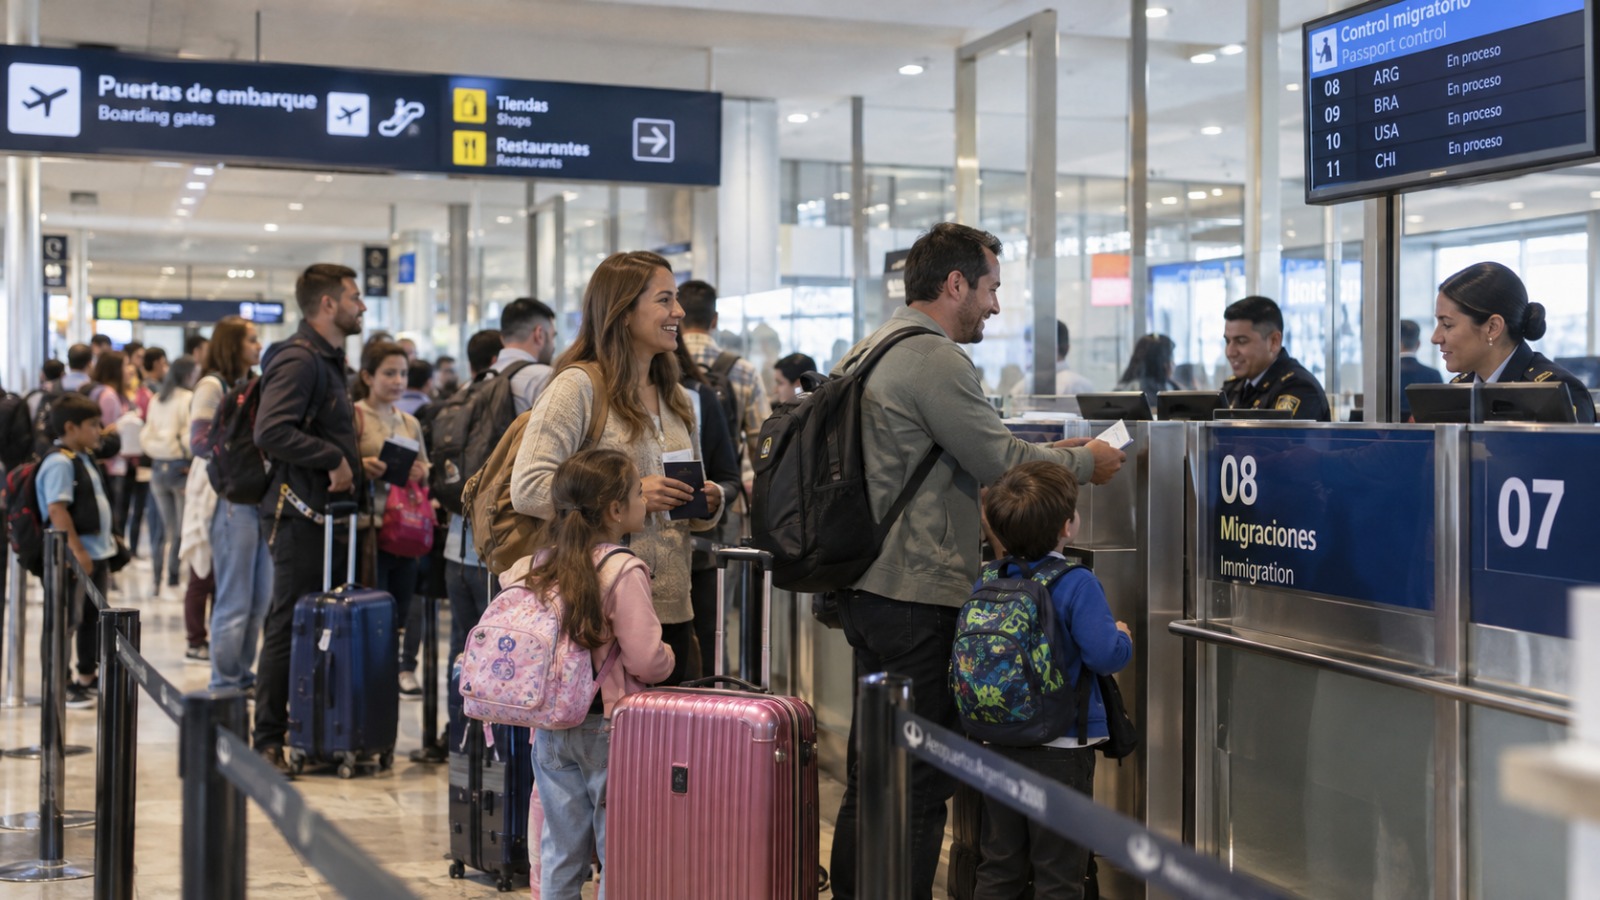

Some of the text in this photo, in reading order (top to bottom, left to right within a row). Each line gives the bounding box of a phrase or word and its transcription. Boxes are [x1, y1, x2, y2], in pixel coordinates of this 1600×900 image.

[1341, 13, 1389, 42] Control
[1342, 20, 1447, 64] Passport control
[1324, 45, 1501, 97] 08 ARG En proceso
[98, 74, 318, 113] Puertas de embarque
[496, 95, 549, 113] Tiendas
[1324, 74, 1501, 123] 09 BRA En proceso
[98, 104, 216, 128] Boarding gates
[496, 112, 532, 128] Shops
[1325, 105, 1502, 150] 10 USA En proceso
[496, 137, 590, 157] Restaurantes
[496, 154, 563, 170] Restaurants
[1326, 134, 1503, 178] 11 CHI En proceso
[1220, 454, 1258, 506] 08
[1498, 476, 1565, 551] 07
[1220, 515, 1317, 551] Migraciones
[1220, 555, 1294, 585] Immigration
